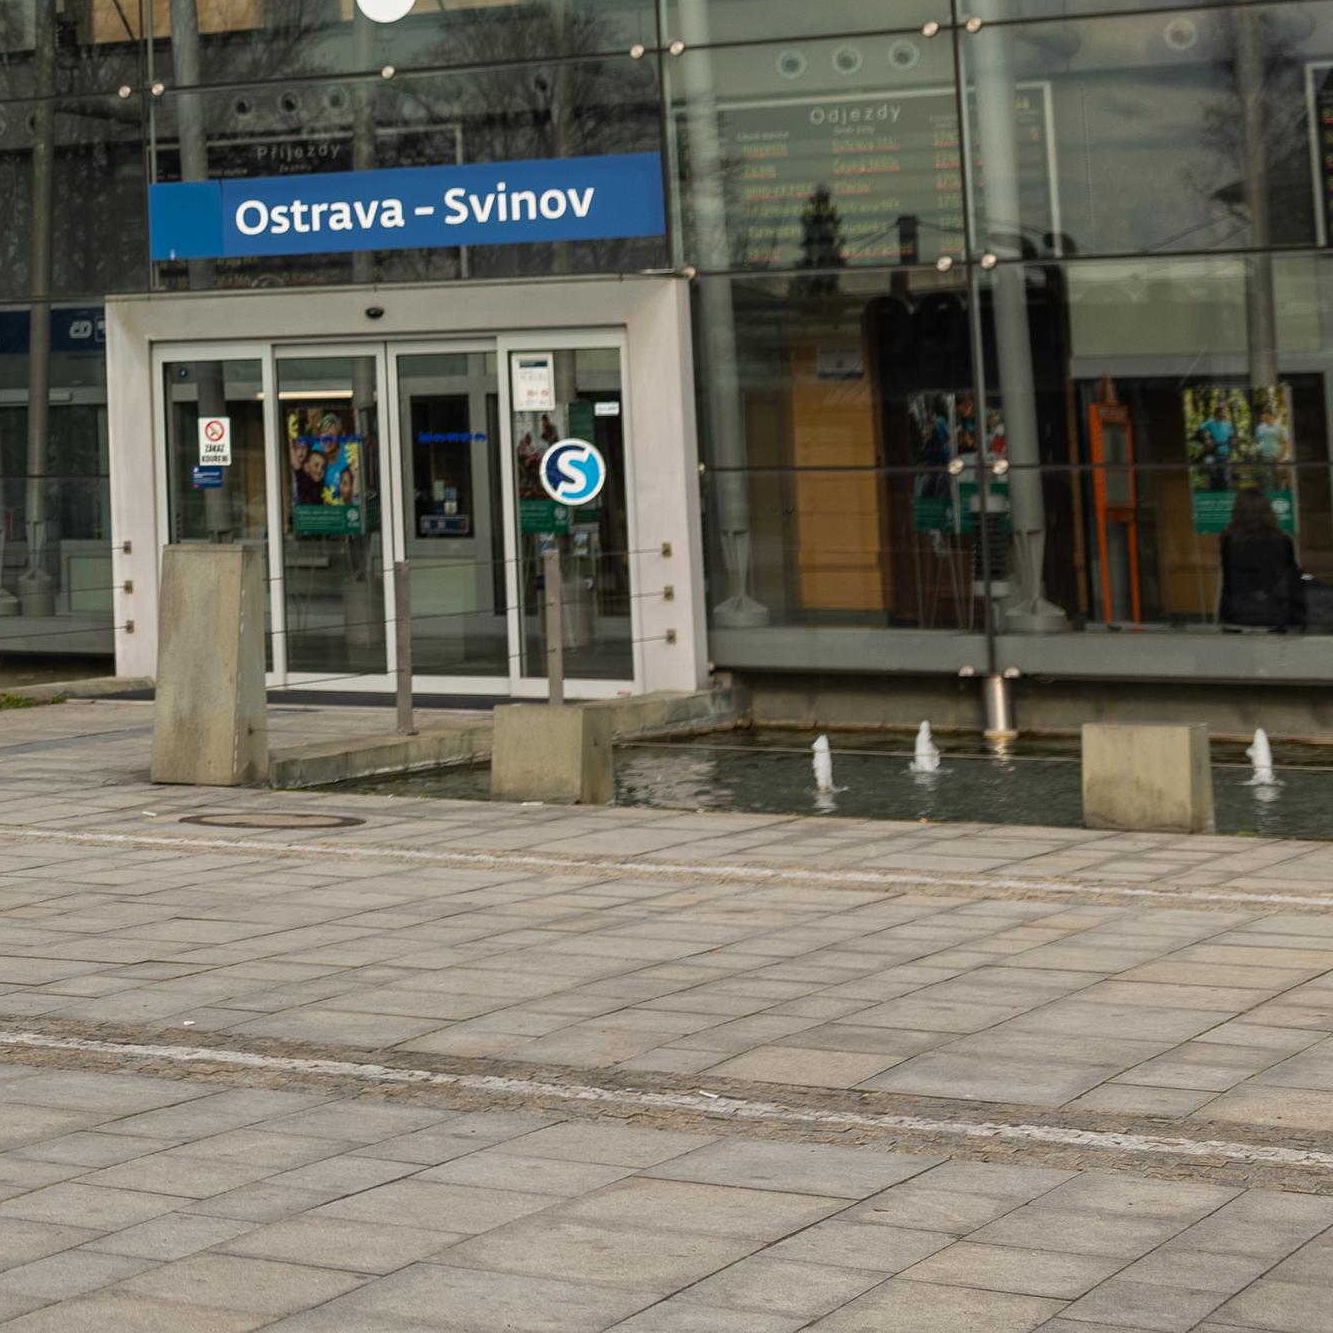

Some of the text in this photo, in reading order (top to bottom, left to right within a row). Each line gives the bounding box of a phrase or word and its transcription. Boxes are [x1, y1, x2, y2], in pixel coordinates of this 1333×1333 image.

[809, 103, 901, 125] Odjezdy
[235, 197, 405, 235] Ostrava
[444, 182, 595, 226] Svinov
